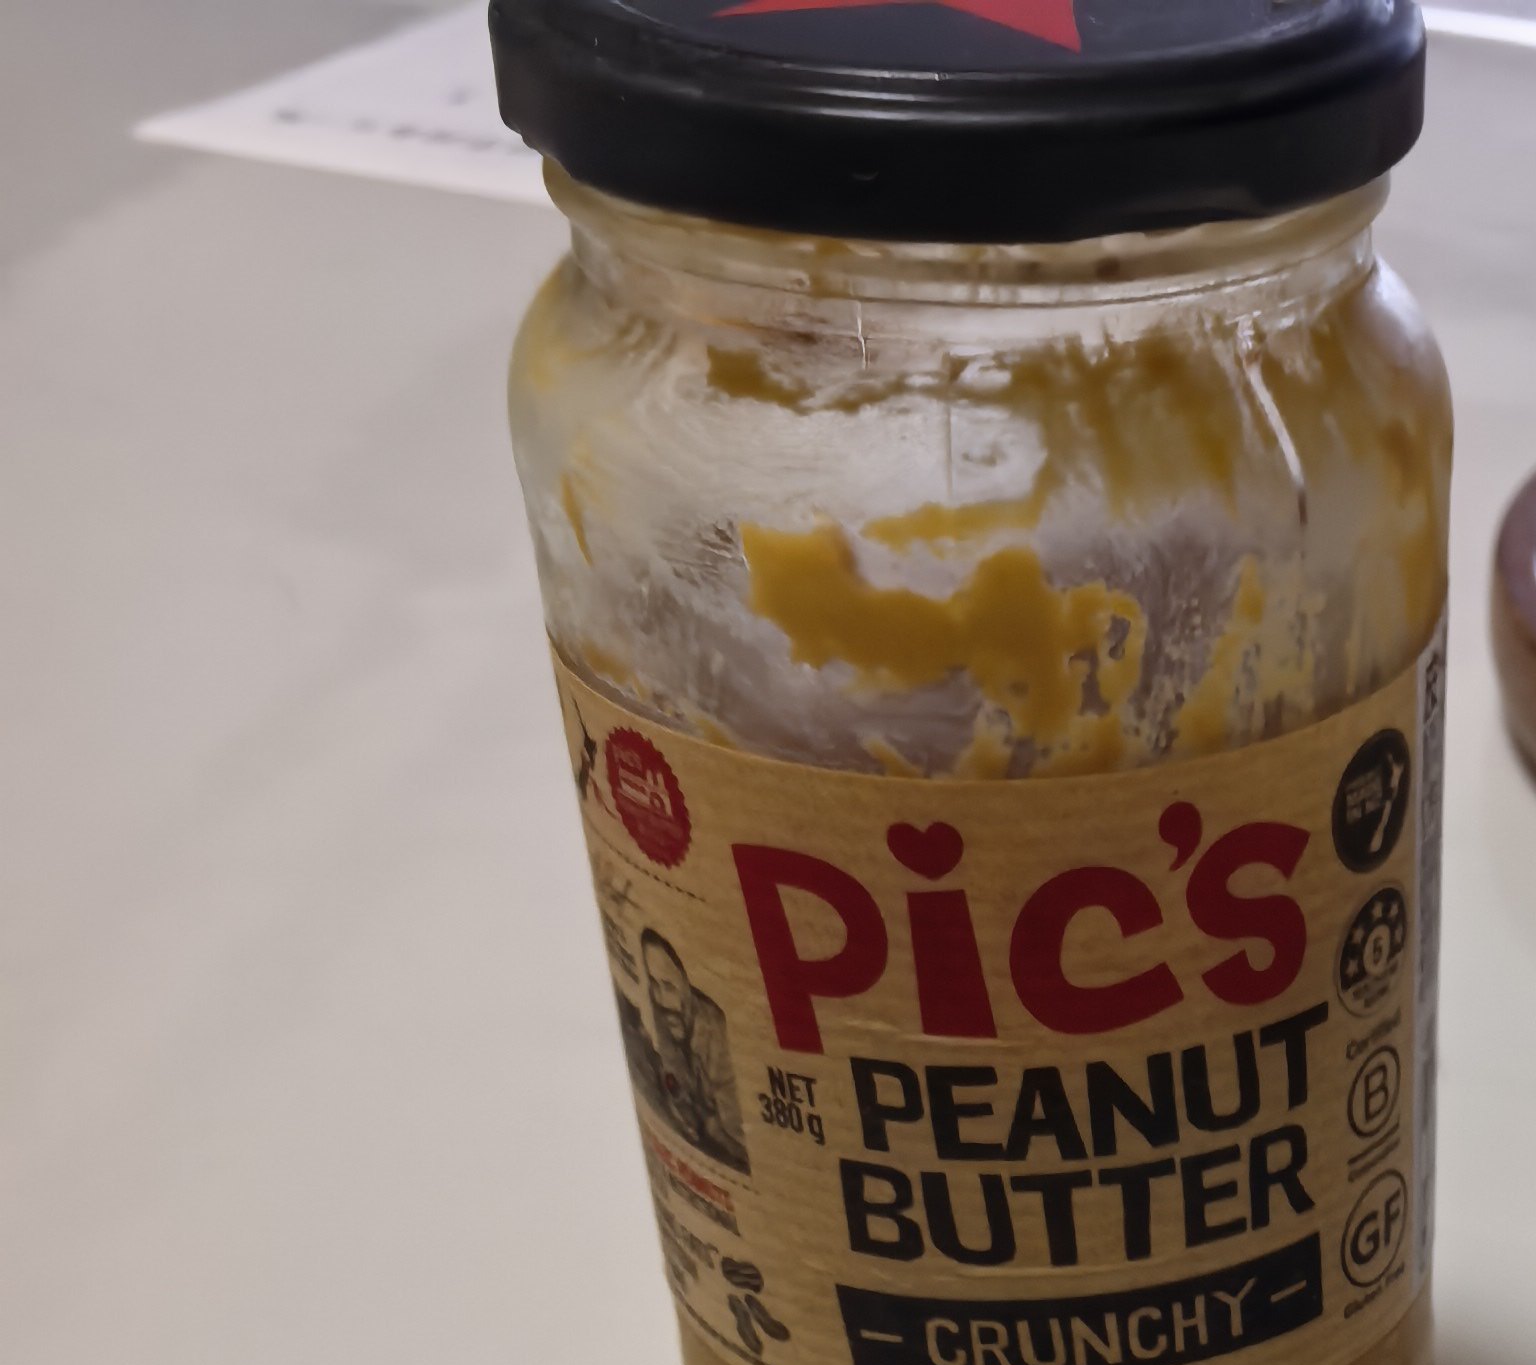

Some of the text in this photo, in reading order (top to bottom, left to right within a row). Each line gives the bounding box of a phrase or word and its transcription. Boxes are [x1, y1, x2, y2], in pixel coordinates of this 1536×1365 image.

[767, 1067, 816, 1107] NET
[850, 1002, 1329, 1161] PEANUT
[839, 1125, 1315, 1267] BUTTER
[1350, 1195, 1402, 1265] GF
